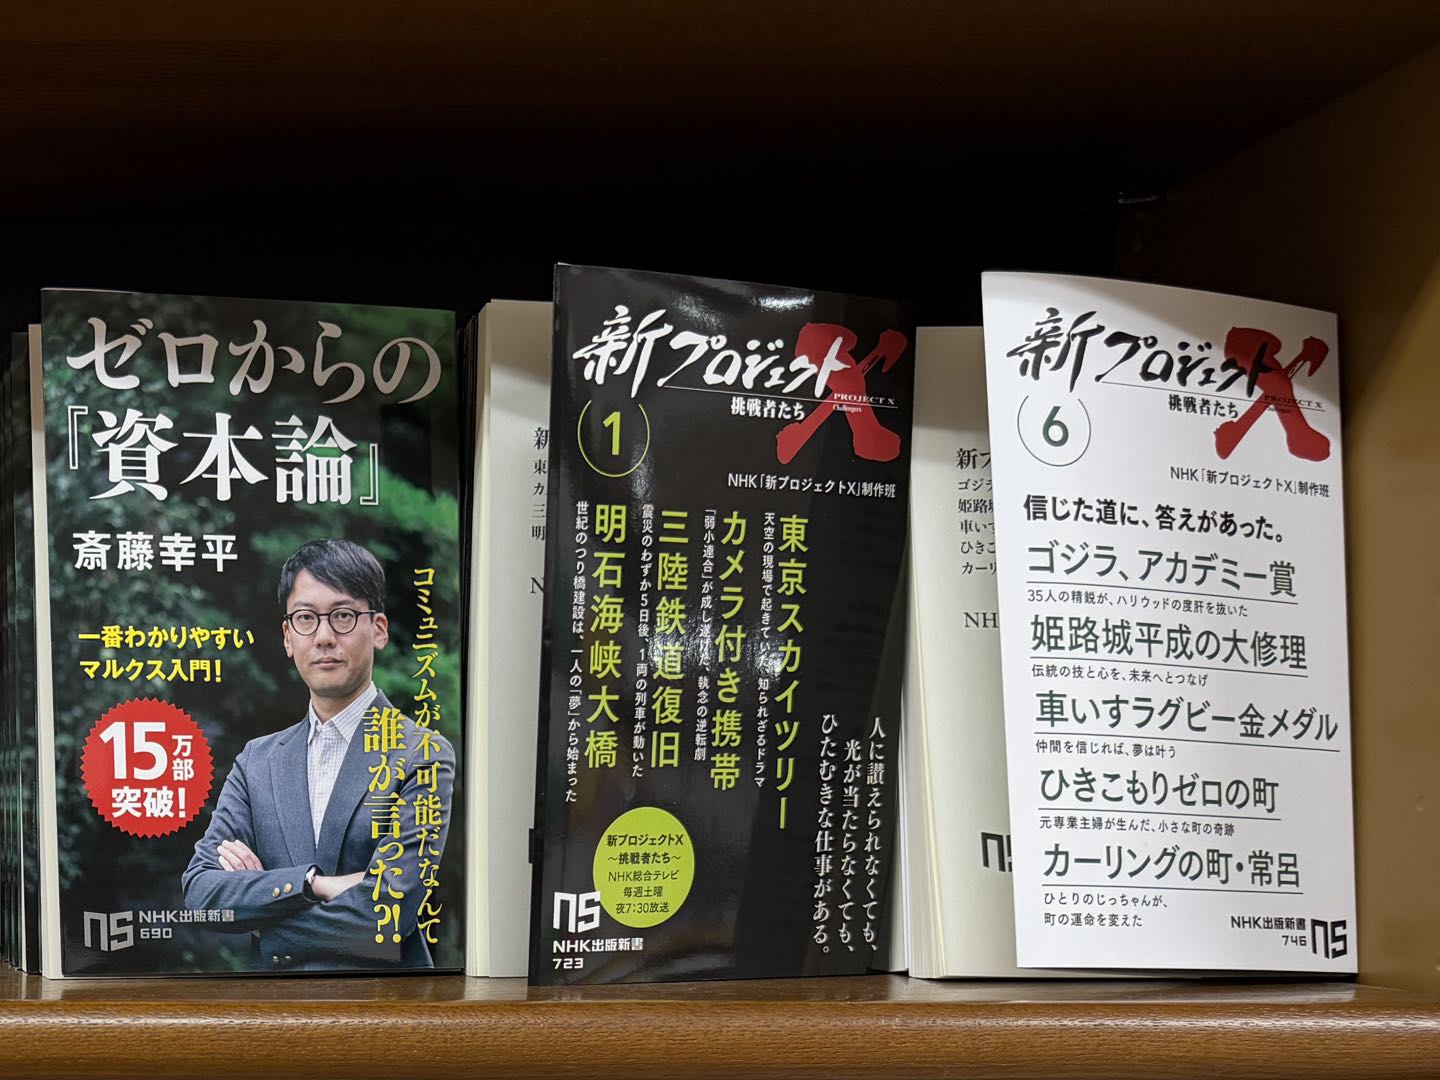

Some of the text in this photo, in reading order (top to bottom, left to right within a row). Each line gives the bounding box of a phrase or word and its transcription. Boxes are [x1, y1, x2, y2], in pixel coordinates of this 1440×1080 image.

[66, 317, 441, 404] ゼロからの
[731, 396, 805, 421] 挑戦者たち
[833, 393, 886, 404] PROJECT
[1168, 394, 1239, 419] 挑戦者たち
[68, 406, 379, 506] 『資本論』
[728, 472, 896, 499] NHK「新プロジェクトX」制作班
[1170, 466, 1330, 498] NHK「新プロジェクトX」制作班
[1023, 494, 1284, 543] 信じた道に、答えがあった。
[73, 531, 238, 572] 斎藤幸平
[1027, 542, 1297, 598] ゴジラ、アカデミー賞
[1027, 589, 1248, 617] 35人の精鋭が、ハリウッドの度肝を抜いた
[78, 626, 255, 650] 一番わかりやすい
[584, 504, 627, 769] 明石海峡大橋
[650, 510, 689, 768] 三陸鉄道復旧
[710, 511, 747, 792] カメラ付き携帯
[1031, 614, 1307, 670] 姫路城平成の大修理
[774, 515, 809, 830] 東京スカイツリー
[1035, 690, 1339, 742] 車いすラグビー金メダル
[412, 567, 443, 944] コミュニズムが不可能だなんて
[1036, 740, 1177, 759] 仲間を信じれば、夢は叶う
[1039, 767, 1279, 814] ひきこもりゼロの町
[607, 834, 684, 848] 新プロジェクトX
[813, 713, 838, 954] ひたむきな仕事がある。
[862, 716, 886, 952] 人に讃えられなくても、
[1039, 816, 1235, 837] 元専業主婦が生んだ、小さな町の奇跡
[837, 739, 860, 953] 光が当たらなくても、
[607, 869, 680, 884] NHK総合テレビ
[1043, 843, 1300, 888] カーリングの町・常呂
[623, 886, 663, 898] 毎週土曜
[139, 909, 234, 923] NHK出版新書
[1044, 912, 1143, 928] 町の運命を変えた
[1231, 916, 1306, 931] NHK出版新書
[140, 928, 172, 939] 690
[553, 937, 643, 953] NHK出版新書
[1282, 935, 1307, 947] 746
[552, 958, 584, 969] 723
